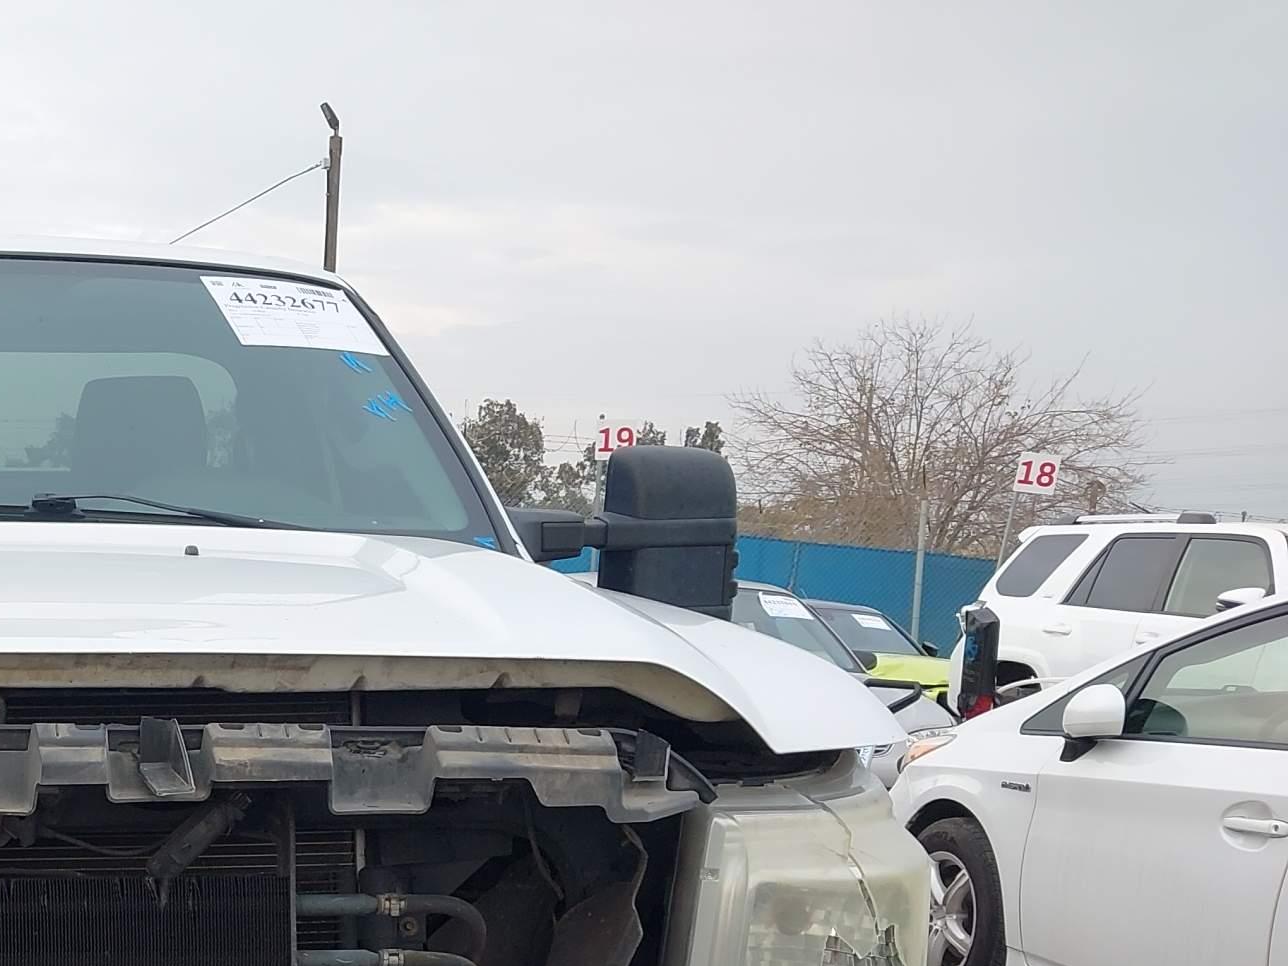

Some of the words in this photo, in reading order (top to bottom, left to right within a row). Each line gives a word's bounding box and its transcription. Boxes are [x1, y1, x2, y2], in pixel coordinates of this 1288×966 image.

[229, 292, 339, 313] 44232677
[598, 427, 634, 452] 19
[1017, 461, 1056, 487] 18
